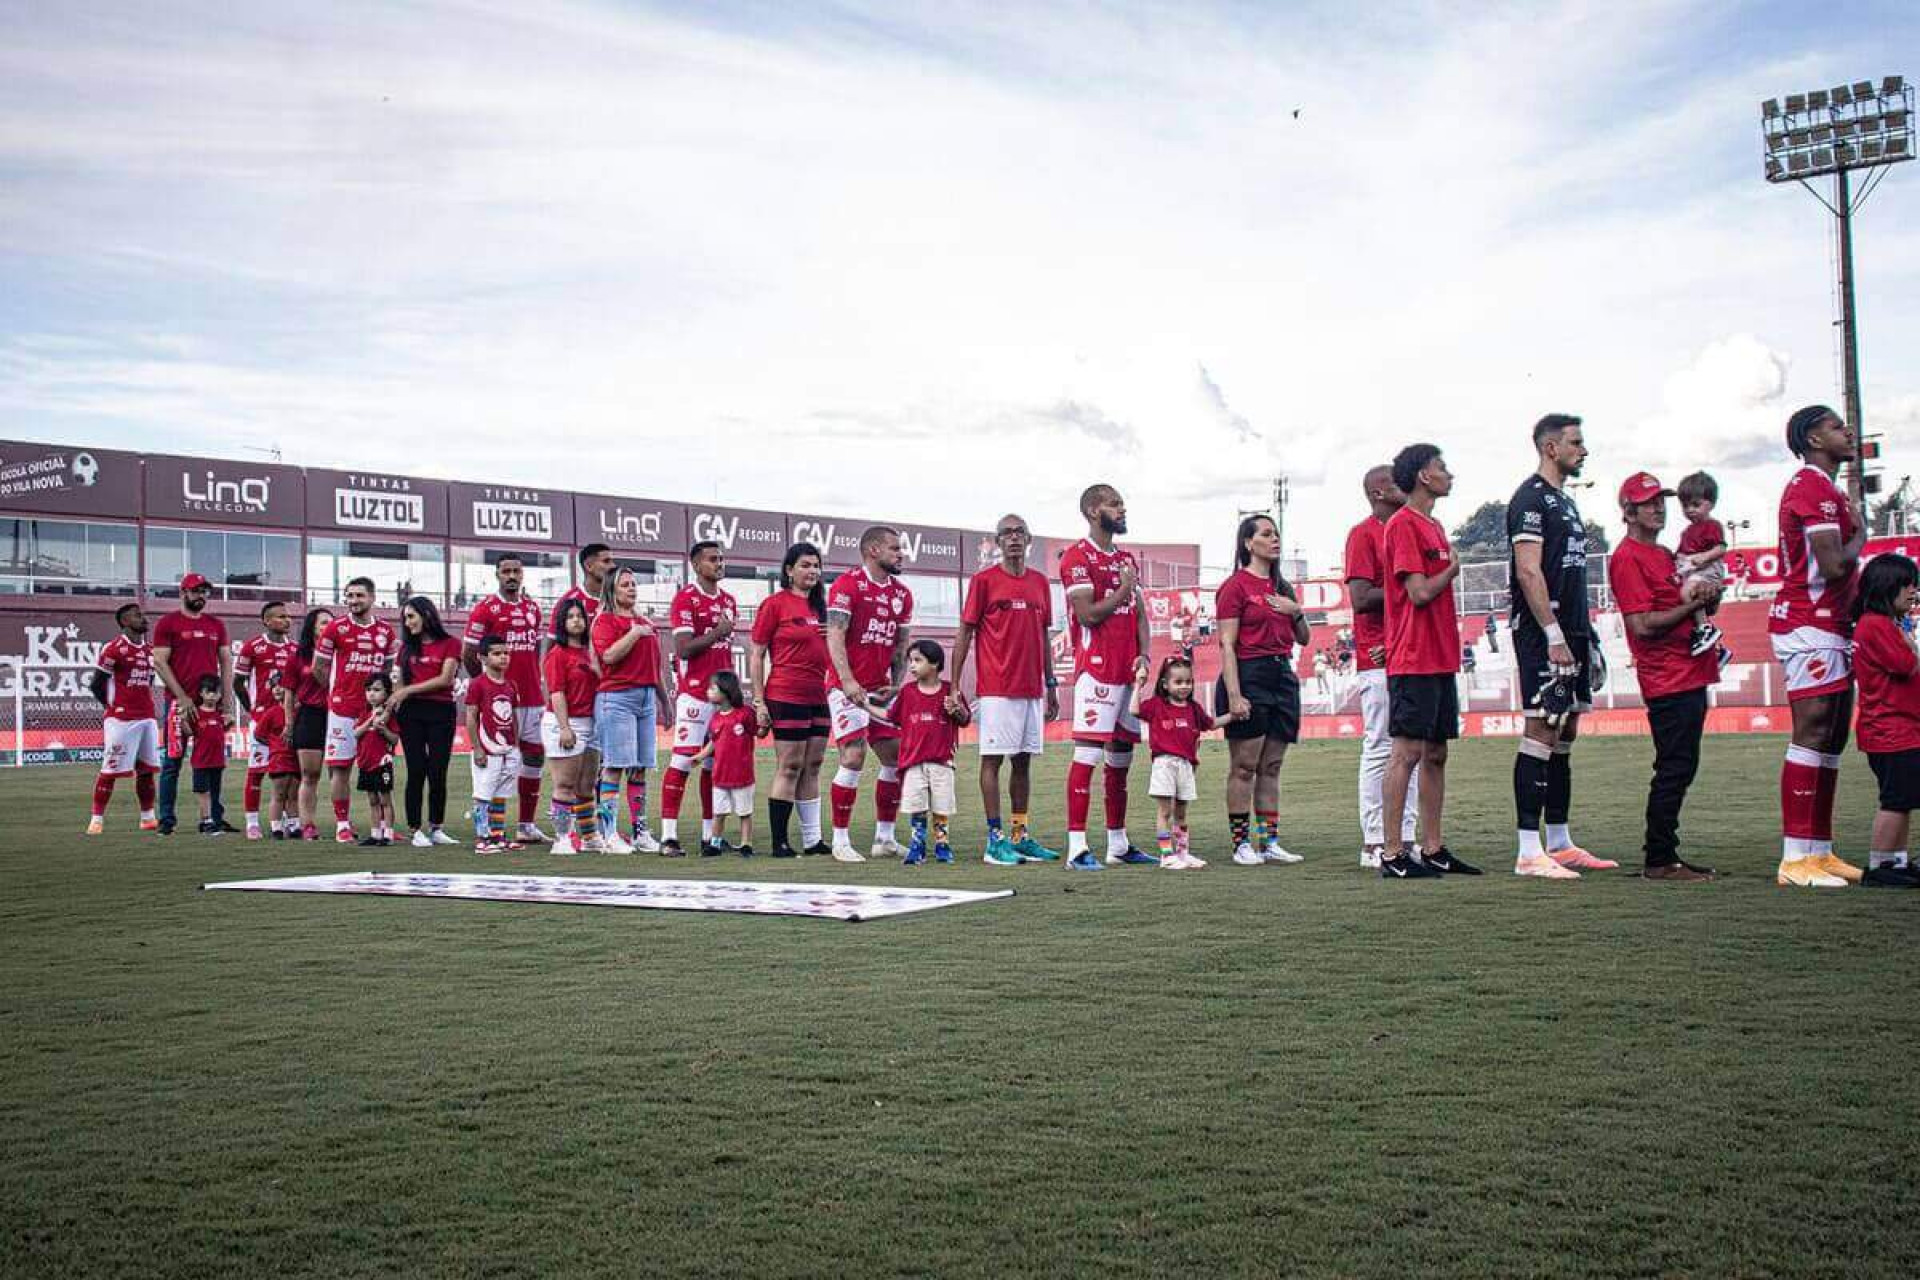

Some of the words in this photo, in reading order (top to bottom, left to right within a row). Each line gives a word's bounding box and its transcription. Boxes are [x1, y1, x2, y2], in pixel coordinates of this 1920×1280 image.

[28, 456, 66, 474] OFICIAL
[33, 474, 64, 489] NOVA
[348, 475, 410, 490] TINTAS
[485, 489, 539, 502] TINTAS
[339, 495, 419, 524] LUZTOL
[477, 508, 548, 534] LUZTOL
[738, 528, 780, 543] RESORTS
[834, 535, 859, 548] RESO
